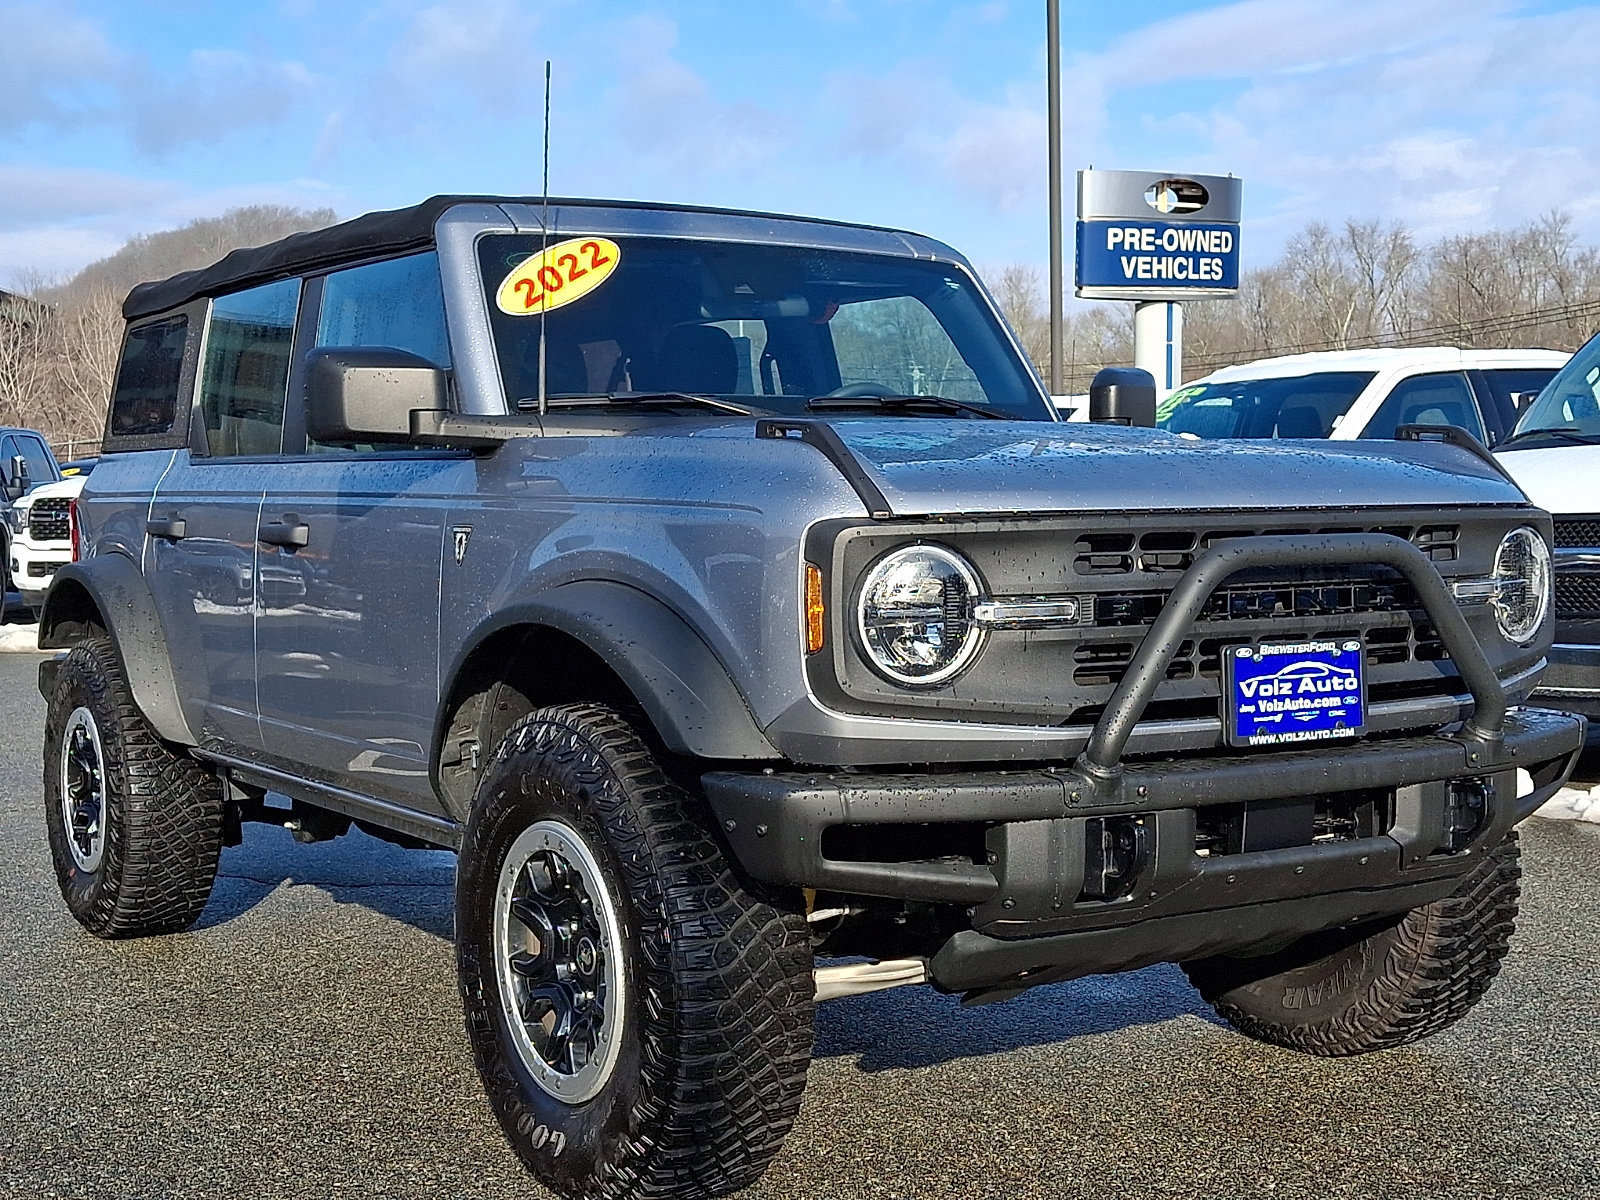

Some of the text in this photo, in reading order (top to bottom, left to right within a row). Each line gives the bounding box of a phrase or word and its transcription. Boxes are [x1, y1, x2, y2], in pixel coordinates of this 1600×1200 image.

[1107, 227, 1233, 253] PRE-OWNED
[514, 241, 610, 308] 2022
[1121, 256, 1223, 281] VEHICLES
[1239, 675, 1358, 698] Volz Auto
[1258, 696, 1342, 713] VolzAuto.com
[1249, 728, 1354, 745] WWW.VOLZAUTO.COM
